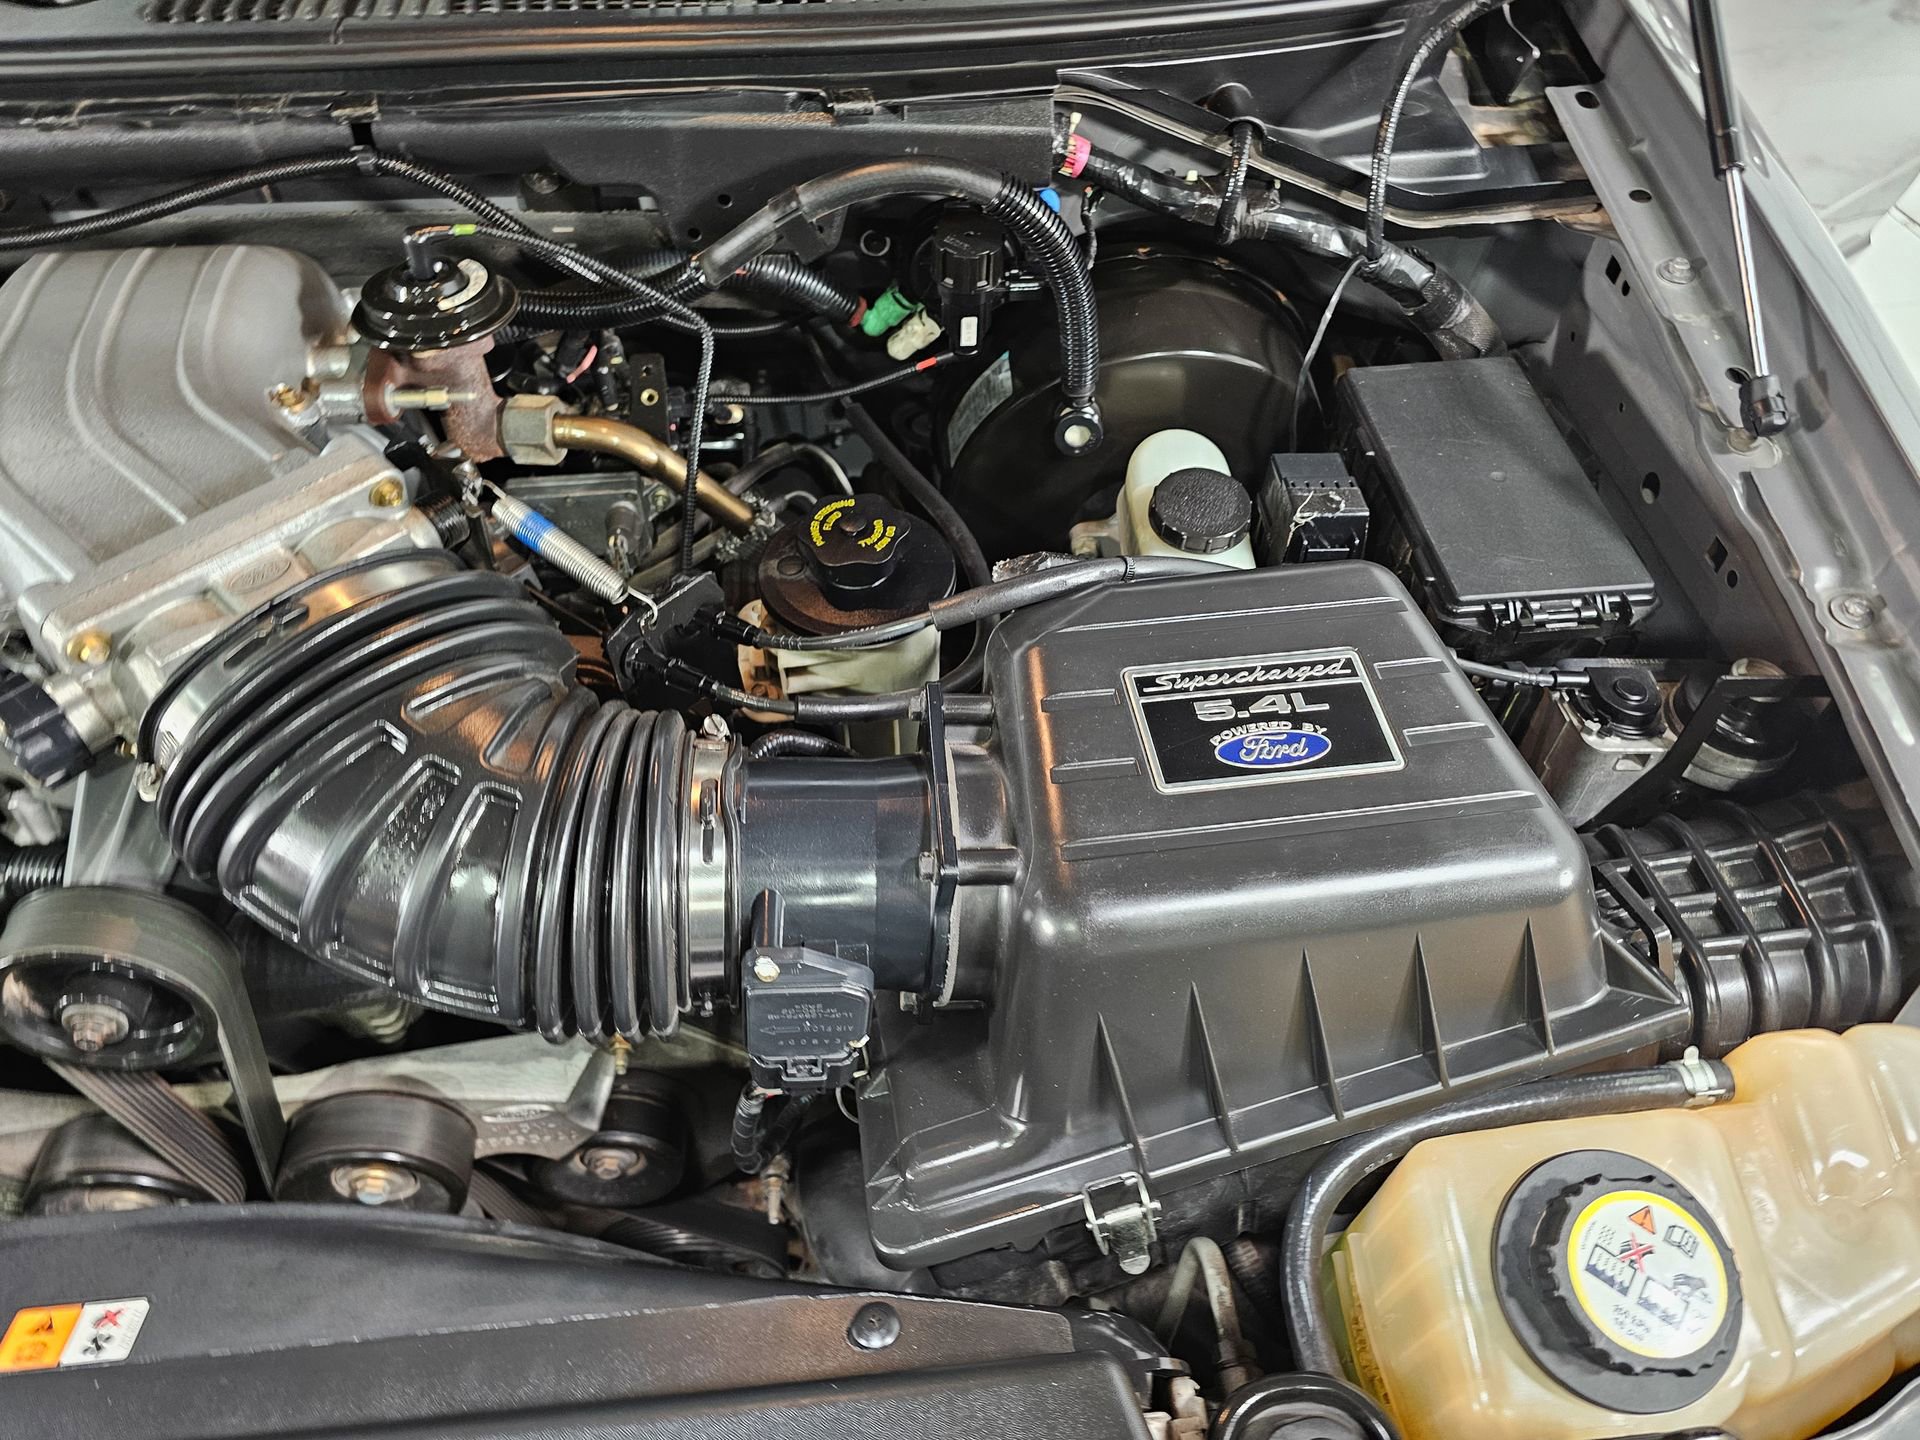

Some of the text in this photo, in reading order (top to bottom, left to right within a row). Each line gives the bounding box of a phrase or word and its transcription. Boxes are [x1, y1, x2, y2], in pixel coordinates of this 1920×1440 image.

[1143, 658, 1352, 692] Supercharged
[1193, 692, 1330, 722] 5.4L
[1210, 720, 1328, 746] POWERED BY
[1239, 734, 1308, 762] Ford
